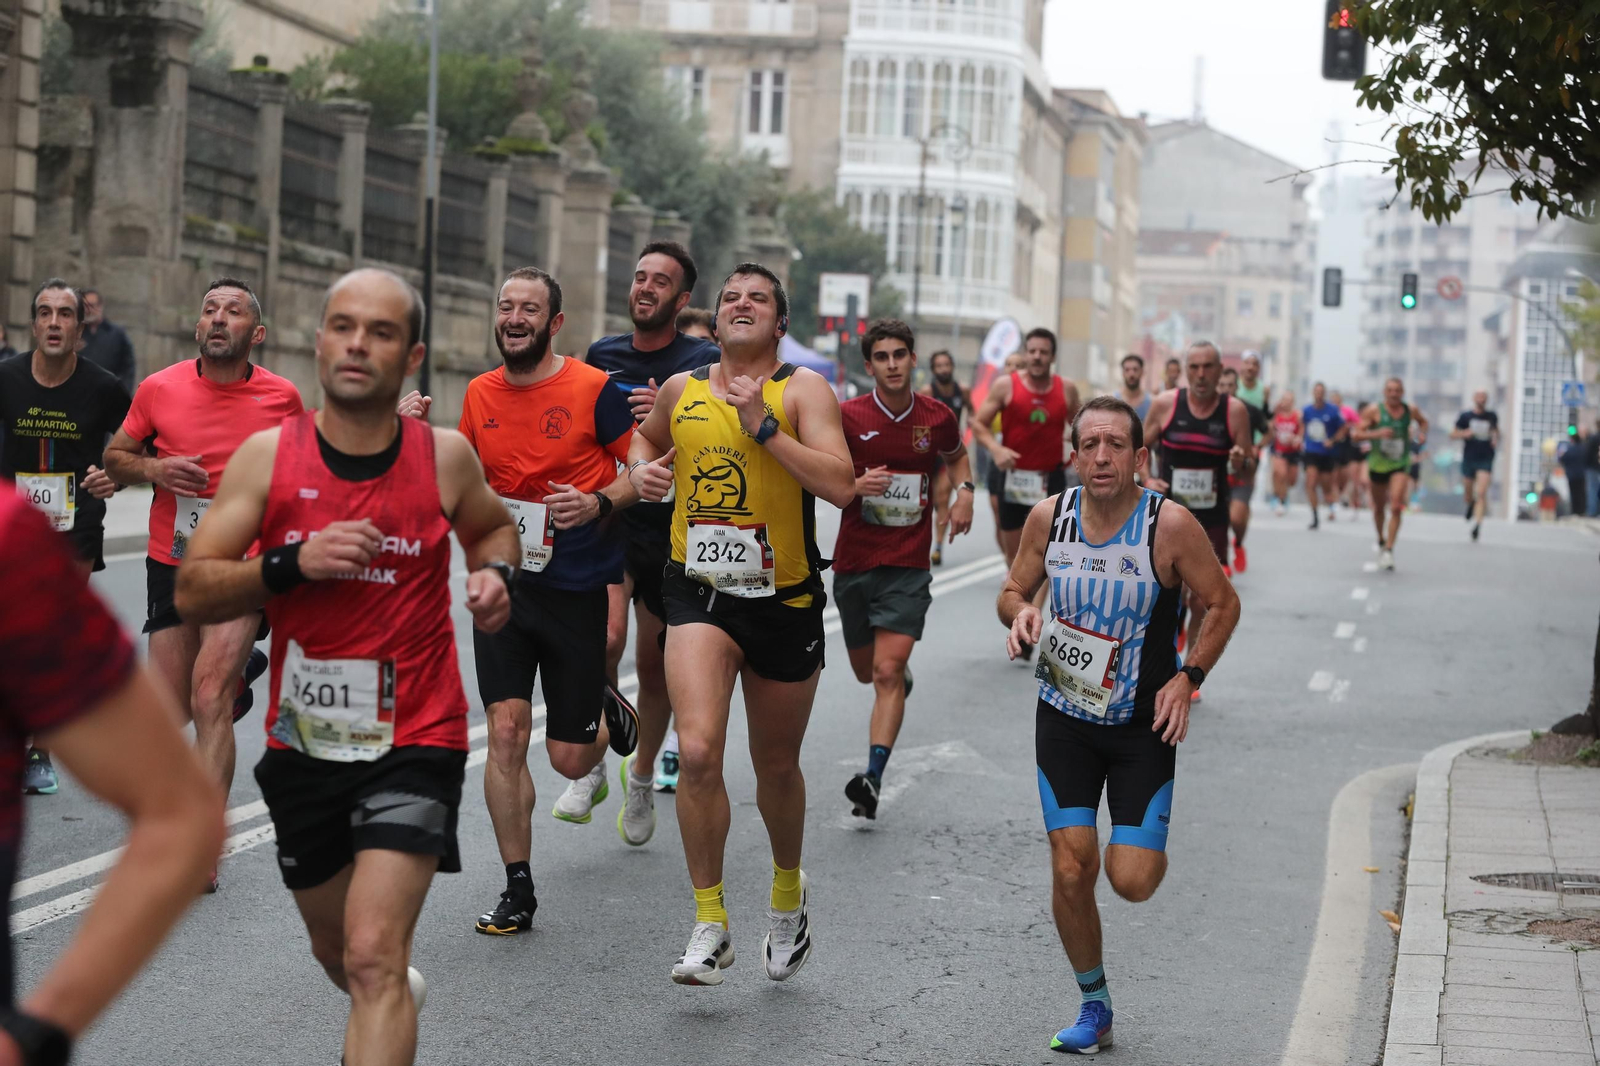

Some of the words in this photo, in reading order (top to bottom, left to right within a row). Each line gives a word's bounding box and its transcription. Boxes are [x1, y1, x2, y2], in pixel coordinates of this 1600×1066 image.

[42, 410, 66, 418] CARREIRA
[17, 418, 33, 428] SAN
[35, 419, 76, 431] MARTIÑO
[43, 430, 51, 438] DE
[692, 445, 748, 469] GANADERÍA
[714, 529, 726, 537] IVAN
[697, 541, 747, 563] 2342
[1061, 628, 1084, 643] EDUARDO
[1049, 635, 1093, 671] 9689
[1082, 686, 1104, 702] XLVIII
